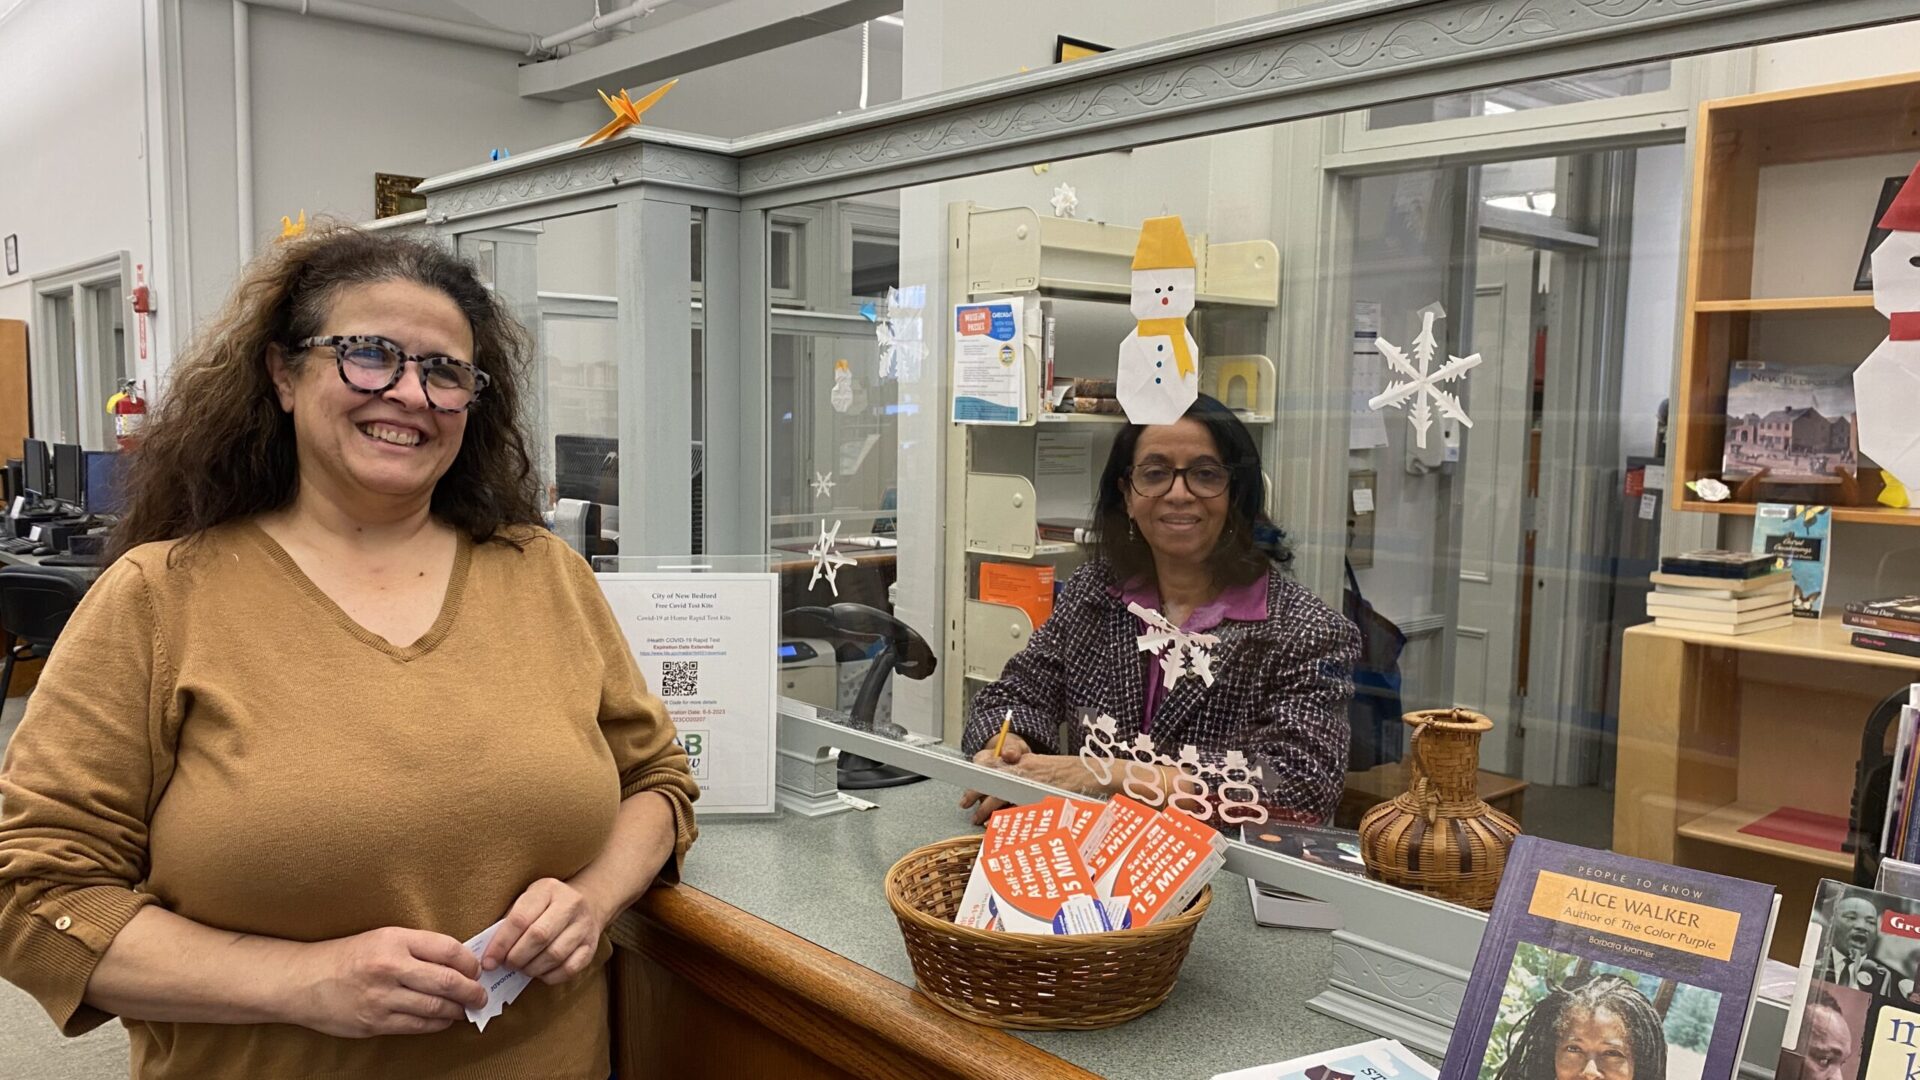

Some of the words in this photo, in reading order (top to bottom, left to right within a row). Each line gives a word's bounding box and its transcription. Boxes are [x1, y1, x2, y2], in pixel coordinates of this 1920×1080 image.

[652, 592, 665, 600] City
[1004, 812, 1024, 845] Home
[1024, 810, 1037, 821] In
[1123, 809, 1135, 822] In
[1029, 843, 1042, 855] In
[1048, 838, 1076, 878] Mins
[1095, 855, 1107, 869] 5
[1106, 815, 1144, 855] Mins
[1127, 828, 1168, 872] Self-Test
[1129, 871, 1144, 885] At
[1141, 834, 1176, 869] Home
[999, 854, 1023, 897] Self-Test
[1015, 849, 1036, 883] Home
[1034, 856, 1060, 899] Results
[1131, 853, 1173, 897] Results
[1171, 840, 1186, 853] In
[1134, 890, 1157, 914] 15
[1155, 849, 1197, 893] Mins
[1578, 865, 1627, 884] PEOPLE
[1636, 878, 1652, 889] TO
[1661, 883, 1704, 899] KNOW
[1026, 884, 1042, 898] At
[1566, 887, 1617, 909] ALICE
[1624, 898, 1700, 929] WALKER
[1563, 906, 1602, 924] Author
[1604, 916, 1617, 926] of
[1621, 919, 1642, 933] The
[1644, 925, 1676, 942] Color
[1677, 934, 1717, 950] Purple
[1588, 935, 1622, 951] Barbara
[1623, 944, 1656, 959] Kramer
